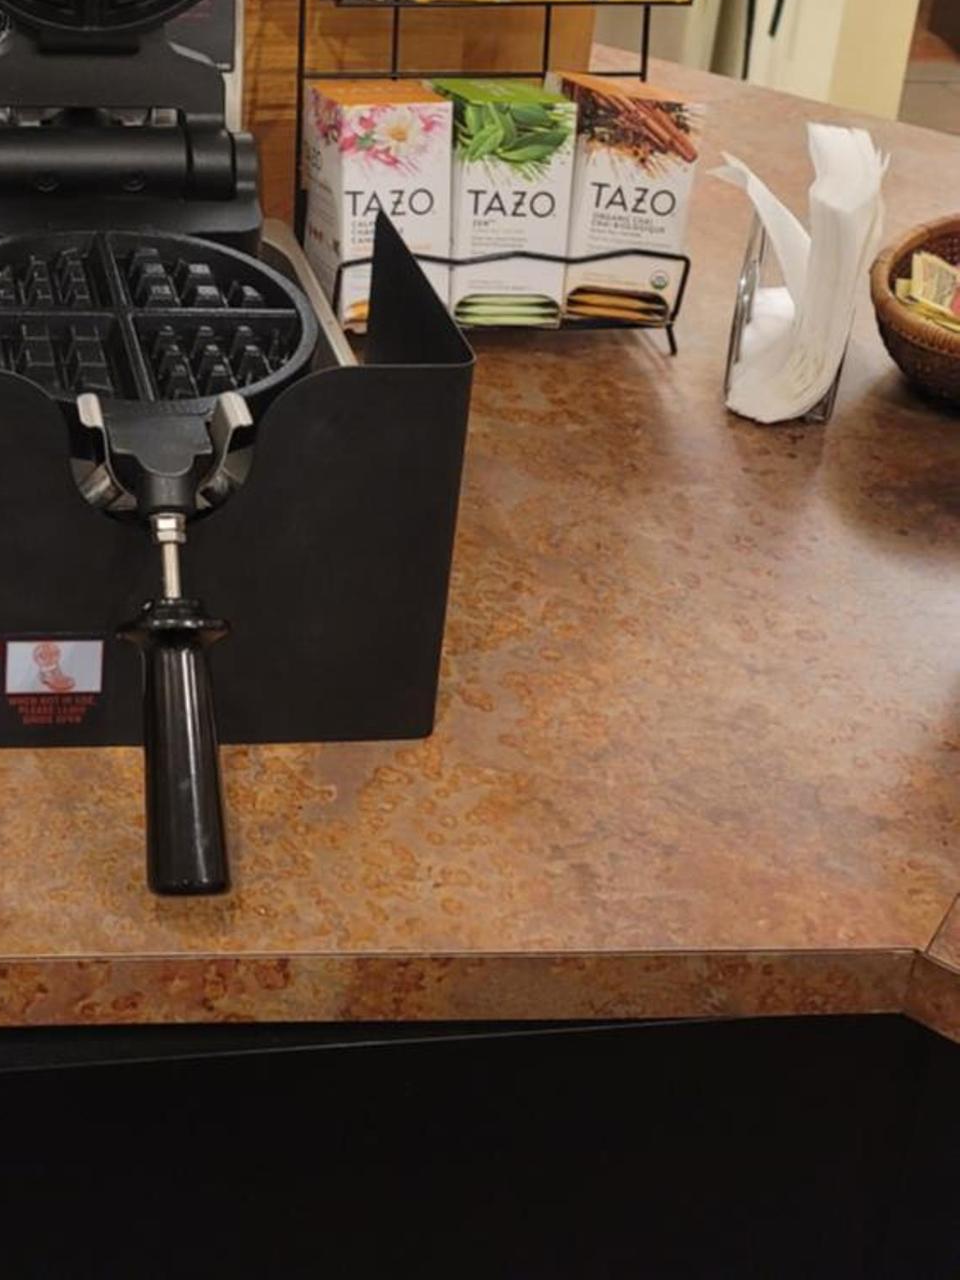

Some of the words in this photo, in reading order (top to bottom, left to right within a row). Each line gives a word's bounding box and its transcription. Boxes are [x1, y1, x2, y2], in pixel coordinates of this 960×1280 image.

[344, 187, 435, 217] TAZO
[467, 188, 556, 218] TAZO
[590, 182, 677, 217] TAZO
